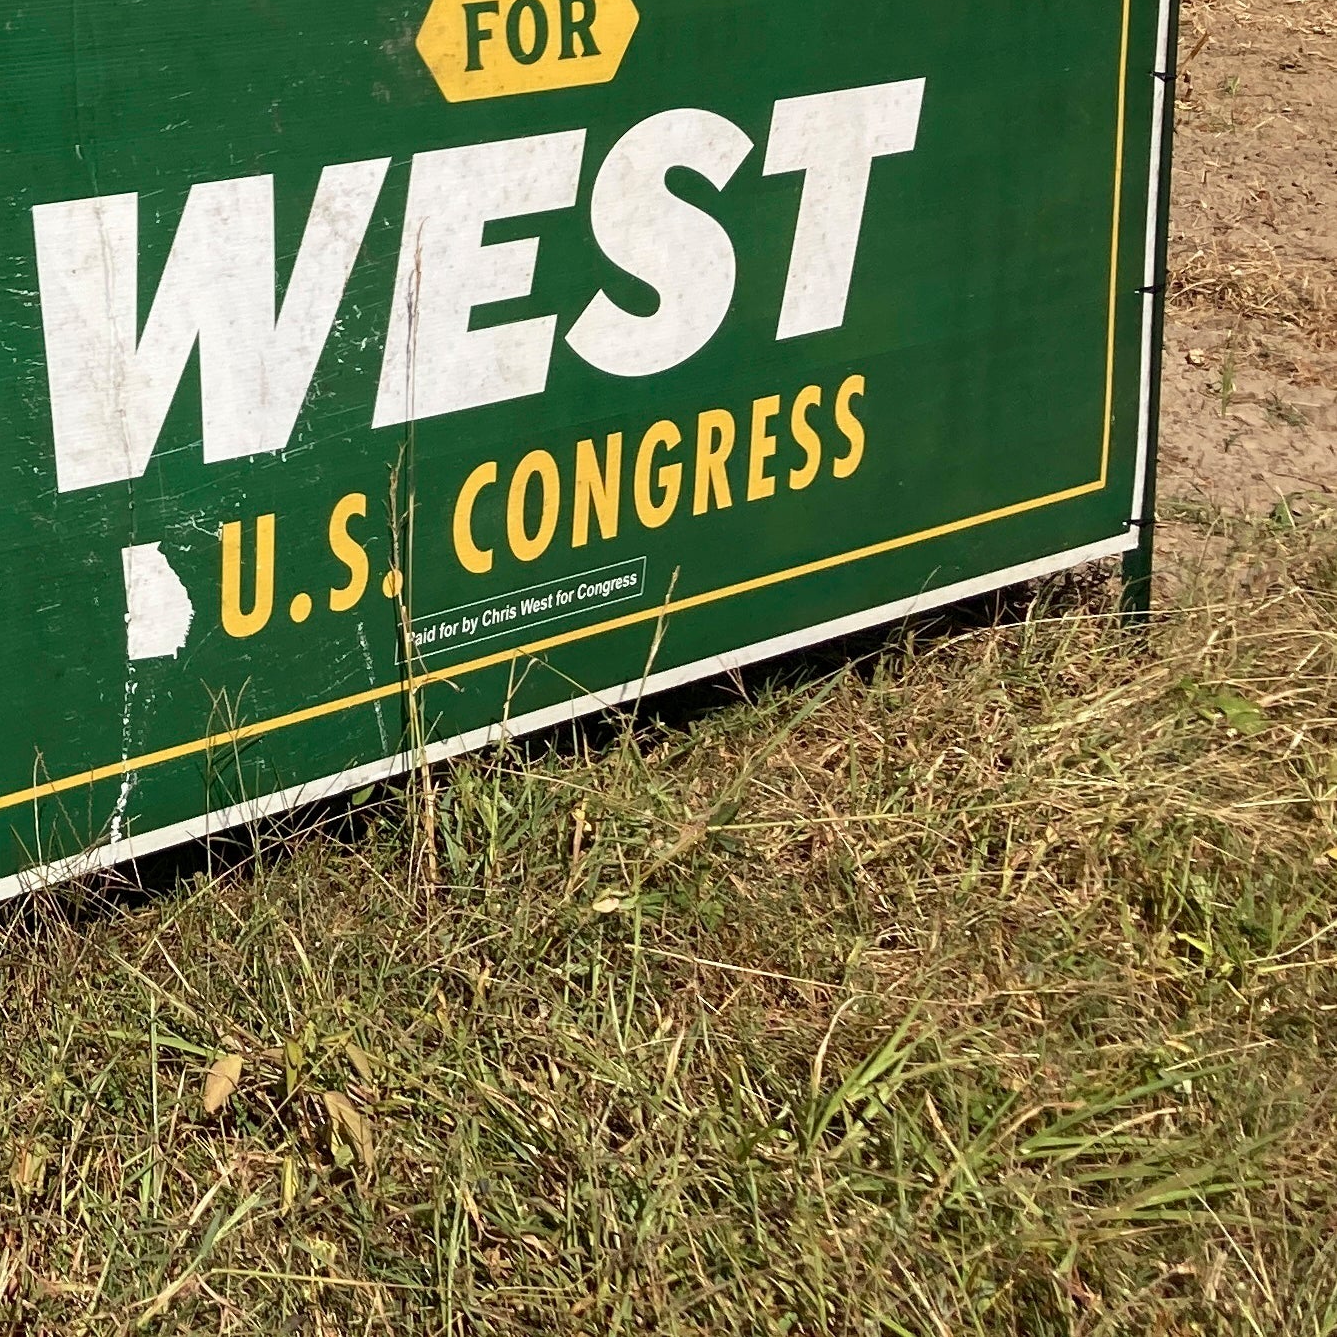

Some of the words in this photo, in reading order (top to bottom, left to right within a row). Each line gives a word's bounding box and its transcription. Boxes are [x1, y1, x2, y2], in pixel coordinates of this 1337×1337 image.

[32, 77, 925, 493] WEST
[220, 492, 403, 637] U.S.
[452, 374, 867, 574] CONGRESS
[439, 622, 459, 639] for
[462, 616, 478, 634] by
[482, 604, 517, 626] Chris
[520, 593, 552, 615] West
[556, 589, 574, 606] for
[577, 573, 637, 597] Congress
